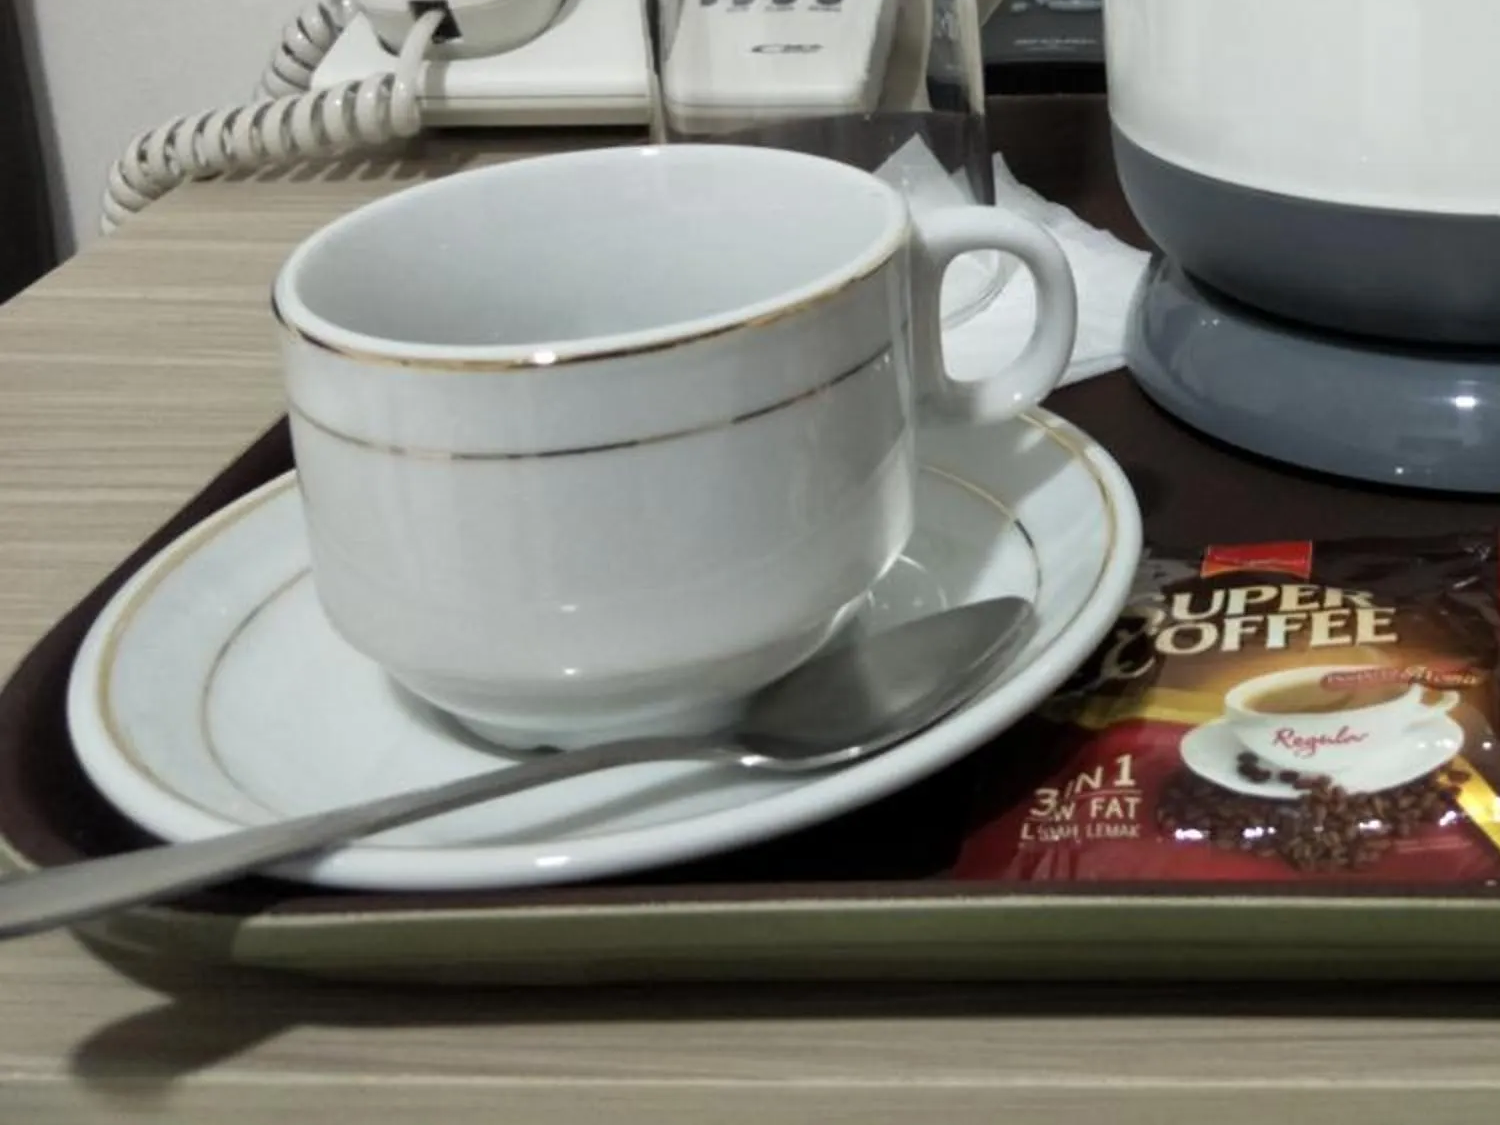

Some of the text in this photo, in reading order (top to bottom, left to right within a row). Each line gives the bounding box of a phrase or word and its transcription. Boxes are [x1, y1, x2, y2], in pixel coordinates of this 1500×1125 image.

[1029, 787, 1060, 817] 3
[1113, 753, 1136, 787] 1
[1090, 796, 1142, 819] FAT
